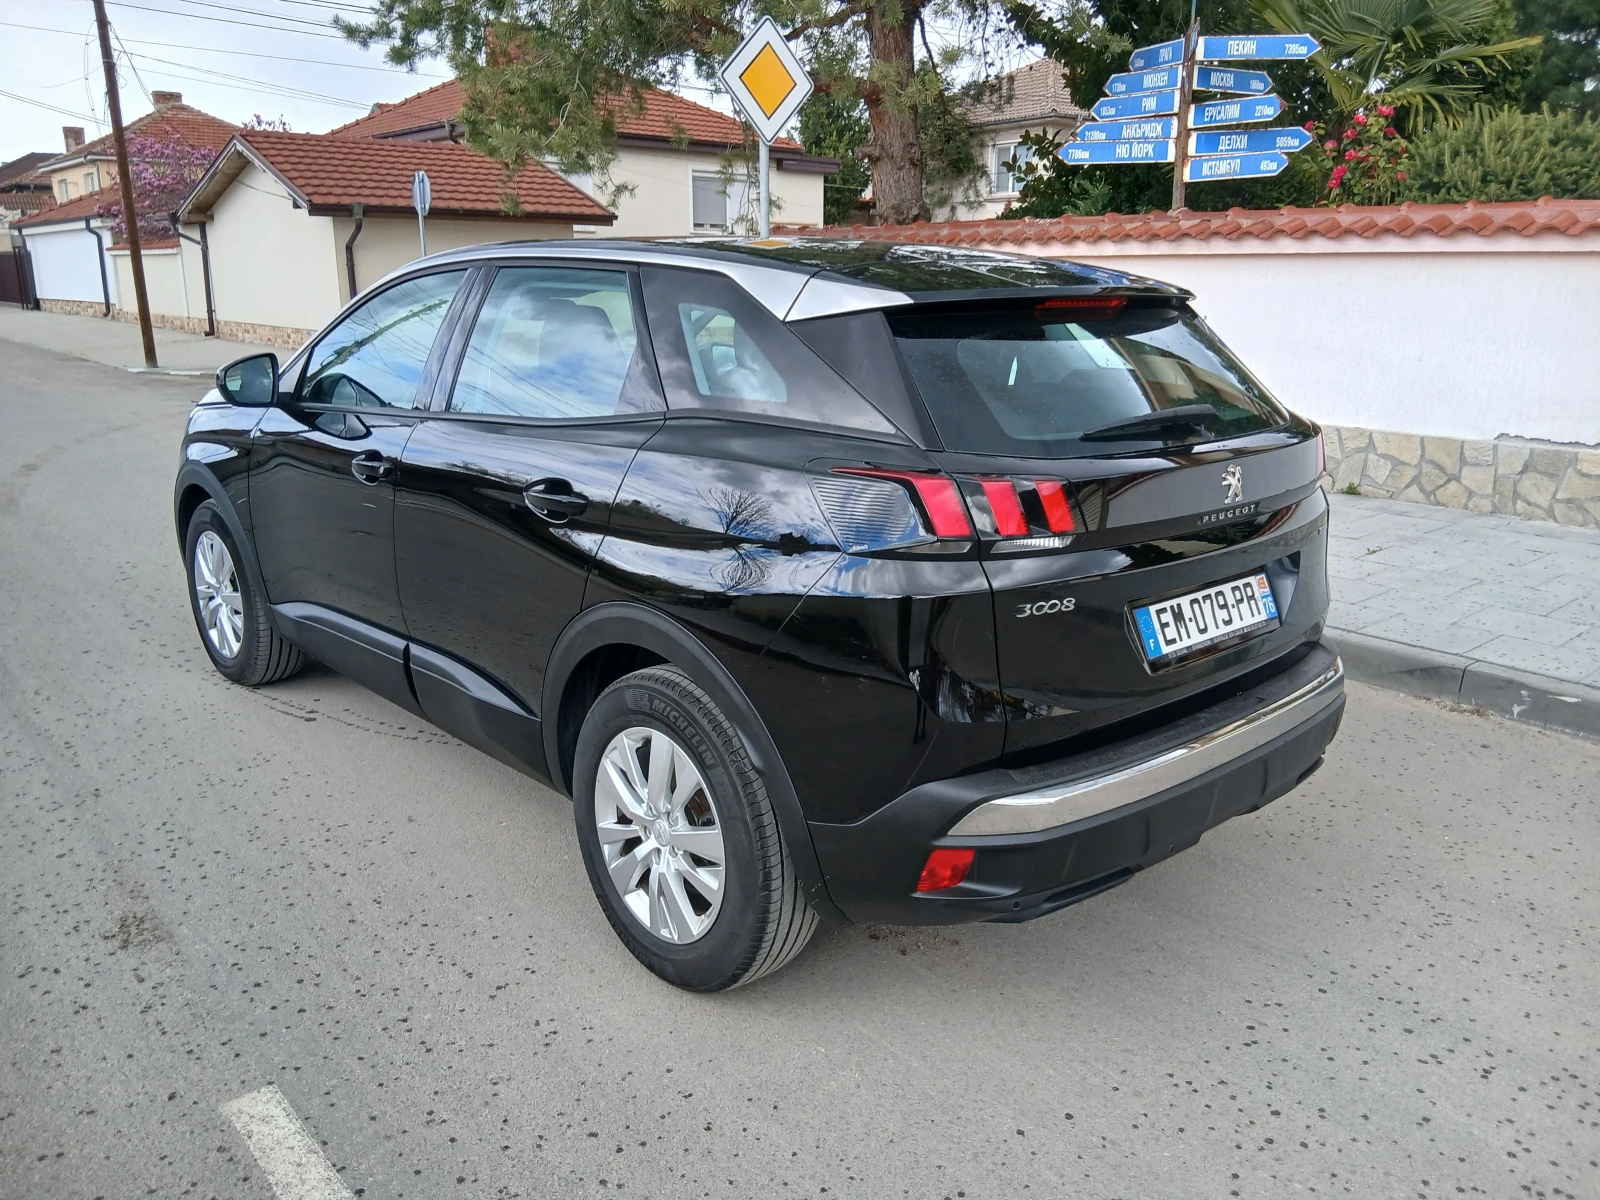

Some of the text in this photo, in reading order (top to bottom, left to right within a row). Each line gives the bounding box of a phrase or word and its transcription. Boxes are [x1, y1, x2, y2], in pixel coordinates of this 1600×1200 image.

[1227, 40, 1257, 56] ПЕКИН
[1142, 71, 1169, 89] МЮНХЕН
[1209, 71, 1234, 88] МОСКВА
[1141, 96, 1157, 112] РИМ
[1204, 103, 1241, 122] ЕРУСАЛИМ
[1121, 121, 1163, 139] АНКЪРИДЖ
[1115, 143, 1130, 159] НЮ
[1131, 141, 1155, 158] ЙОРК
[1217, 134, 1248, 152] ДЕЛХИ
[1201, 158, 1241, 176] ИСТАМБУЛ
[1202, 504, 1256, 524] PEUGEOT
[1014, 597, 1076, 618] 3008
[1154, 581, 1262, 647] EM-079-PR
[1262, 596, 1276, 615] 76
[1148, 638, 1156, 651] F
[651, 698, 716, 766] MICHELIN
